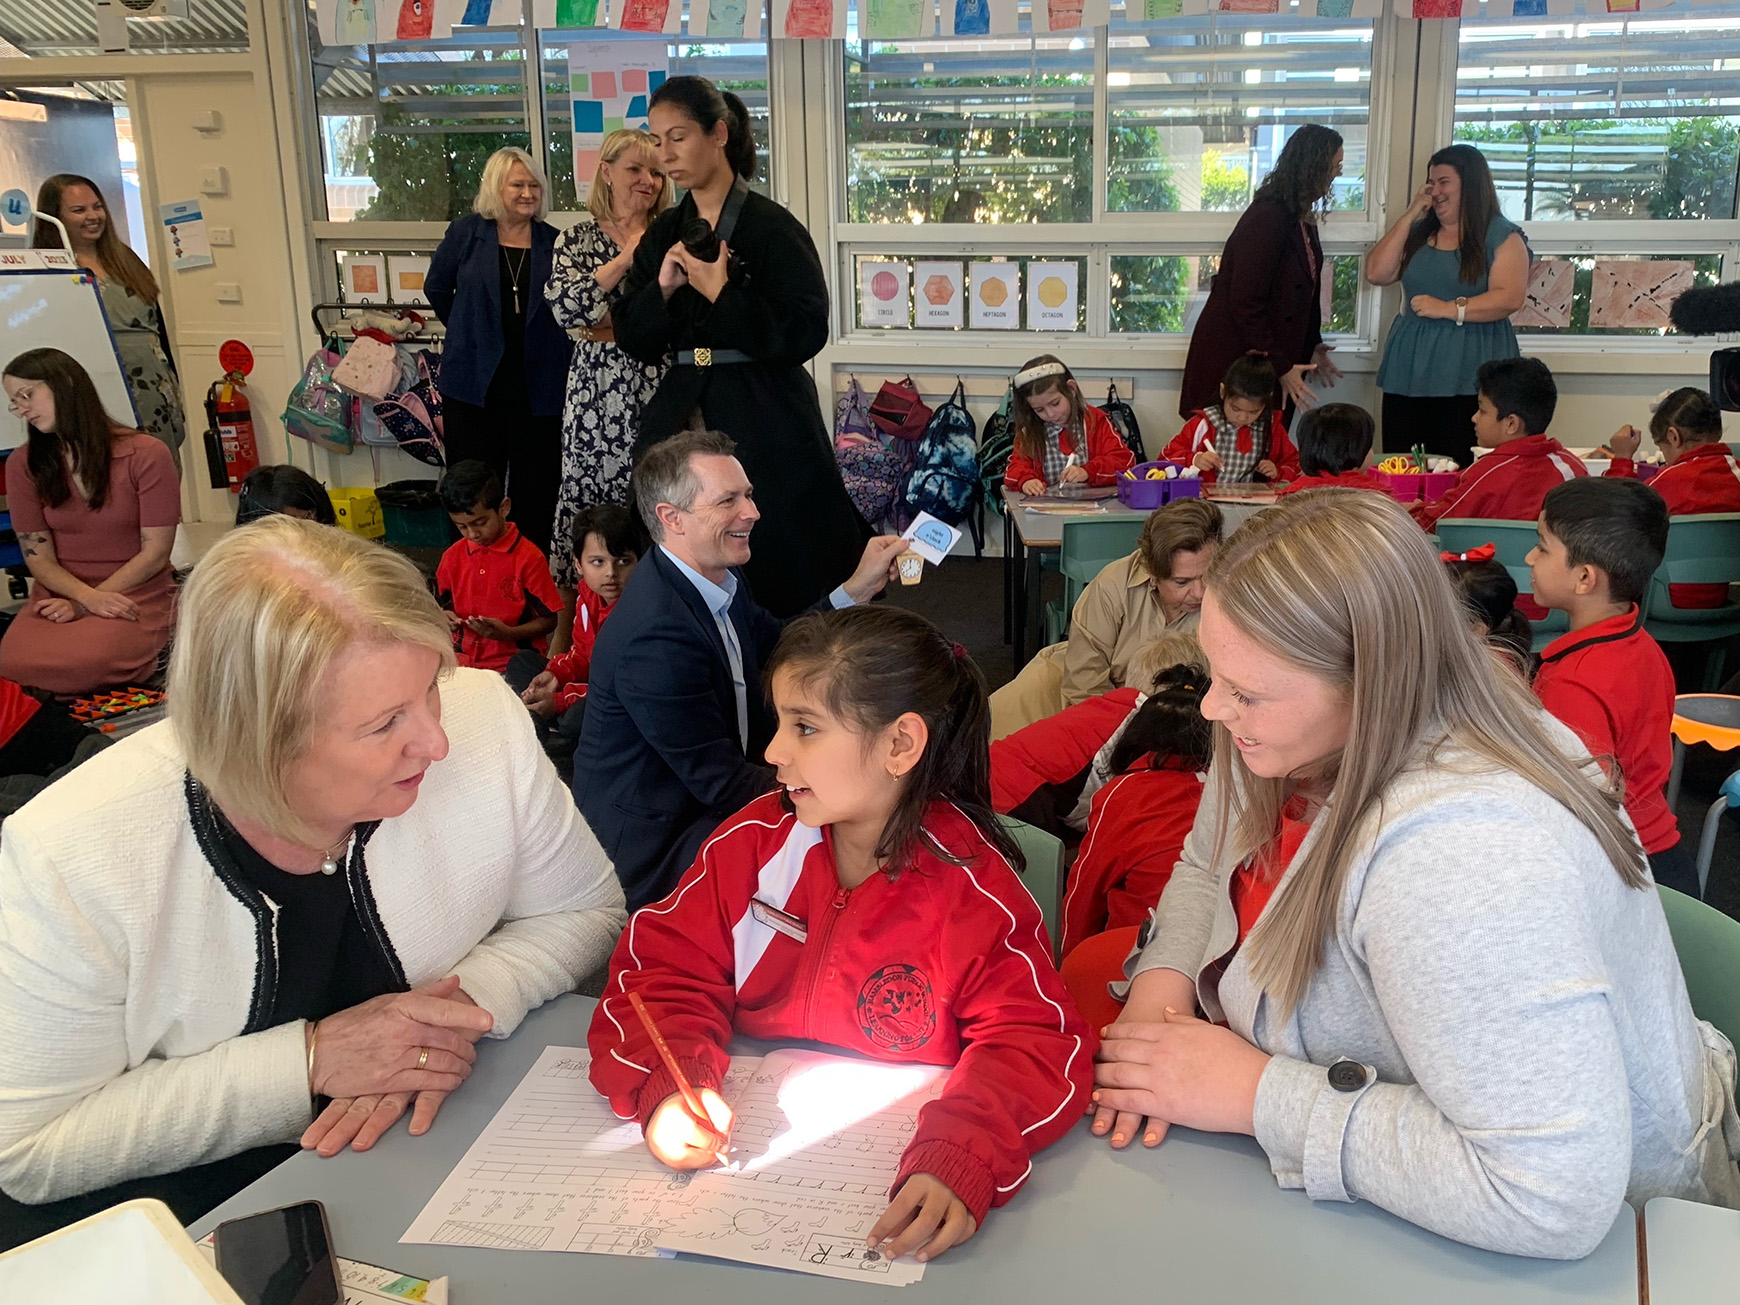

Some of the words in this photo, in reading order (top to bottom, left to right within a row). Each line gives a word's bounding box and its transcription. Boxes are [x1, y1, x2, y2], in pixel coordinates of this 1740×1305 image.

[8, 198, 21, 214] u
[1, 255, 26, 264] JULY
[45, 256, 68, 264] 2023
[869, 1015, 899, 1041] LEARNING
[810, 1243, 833, 1265] R
